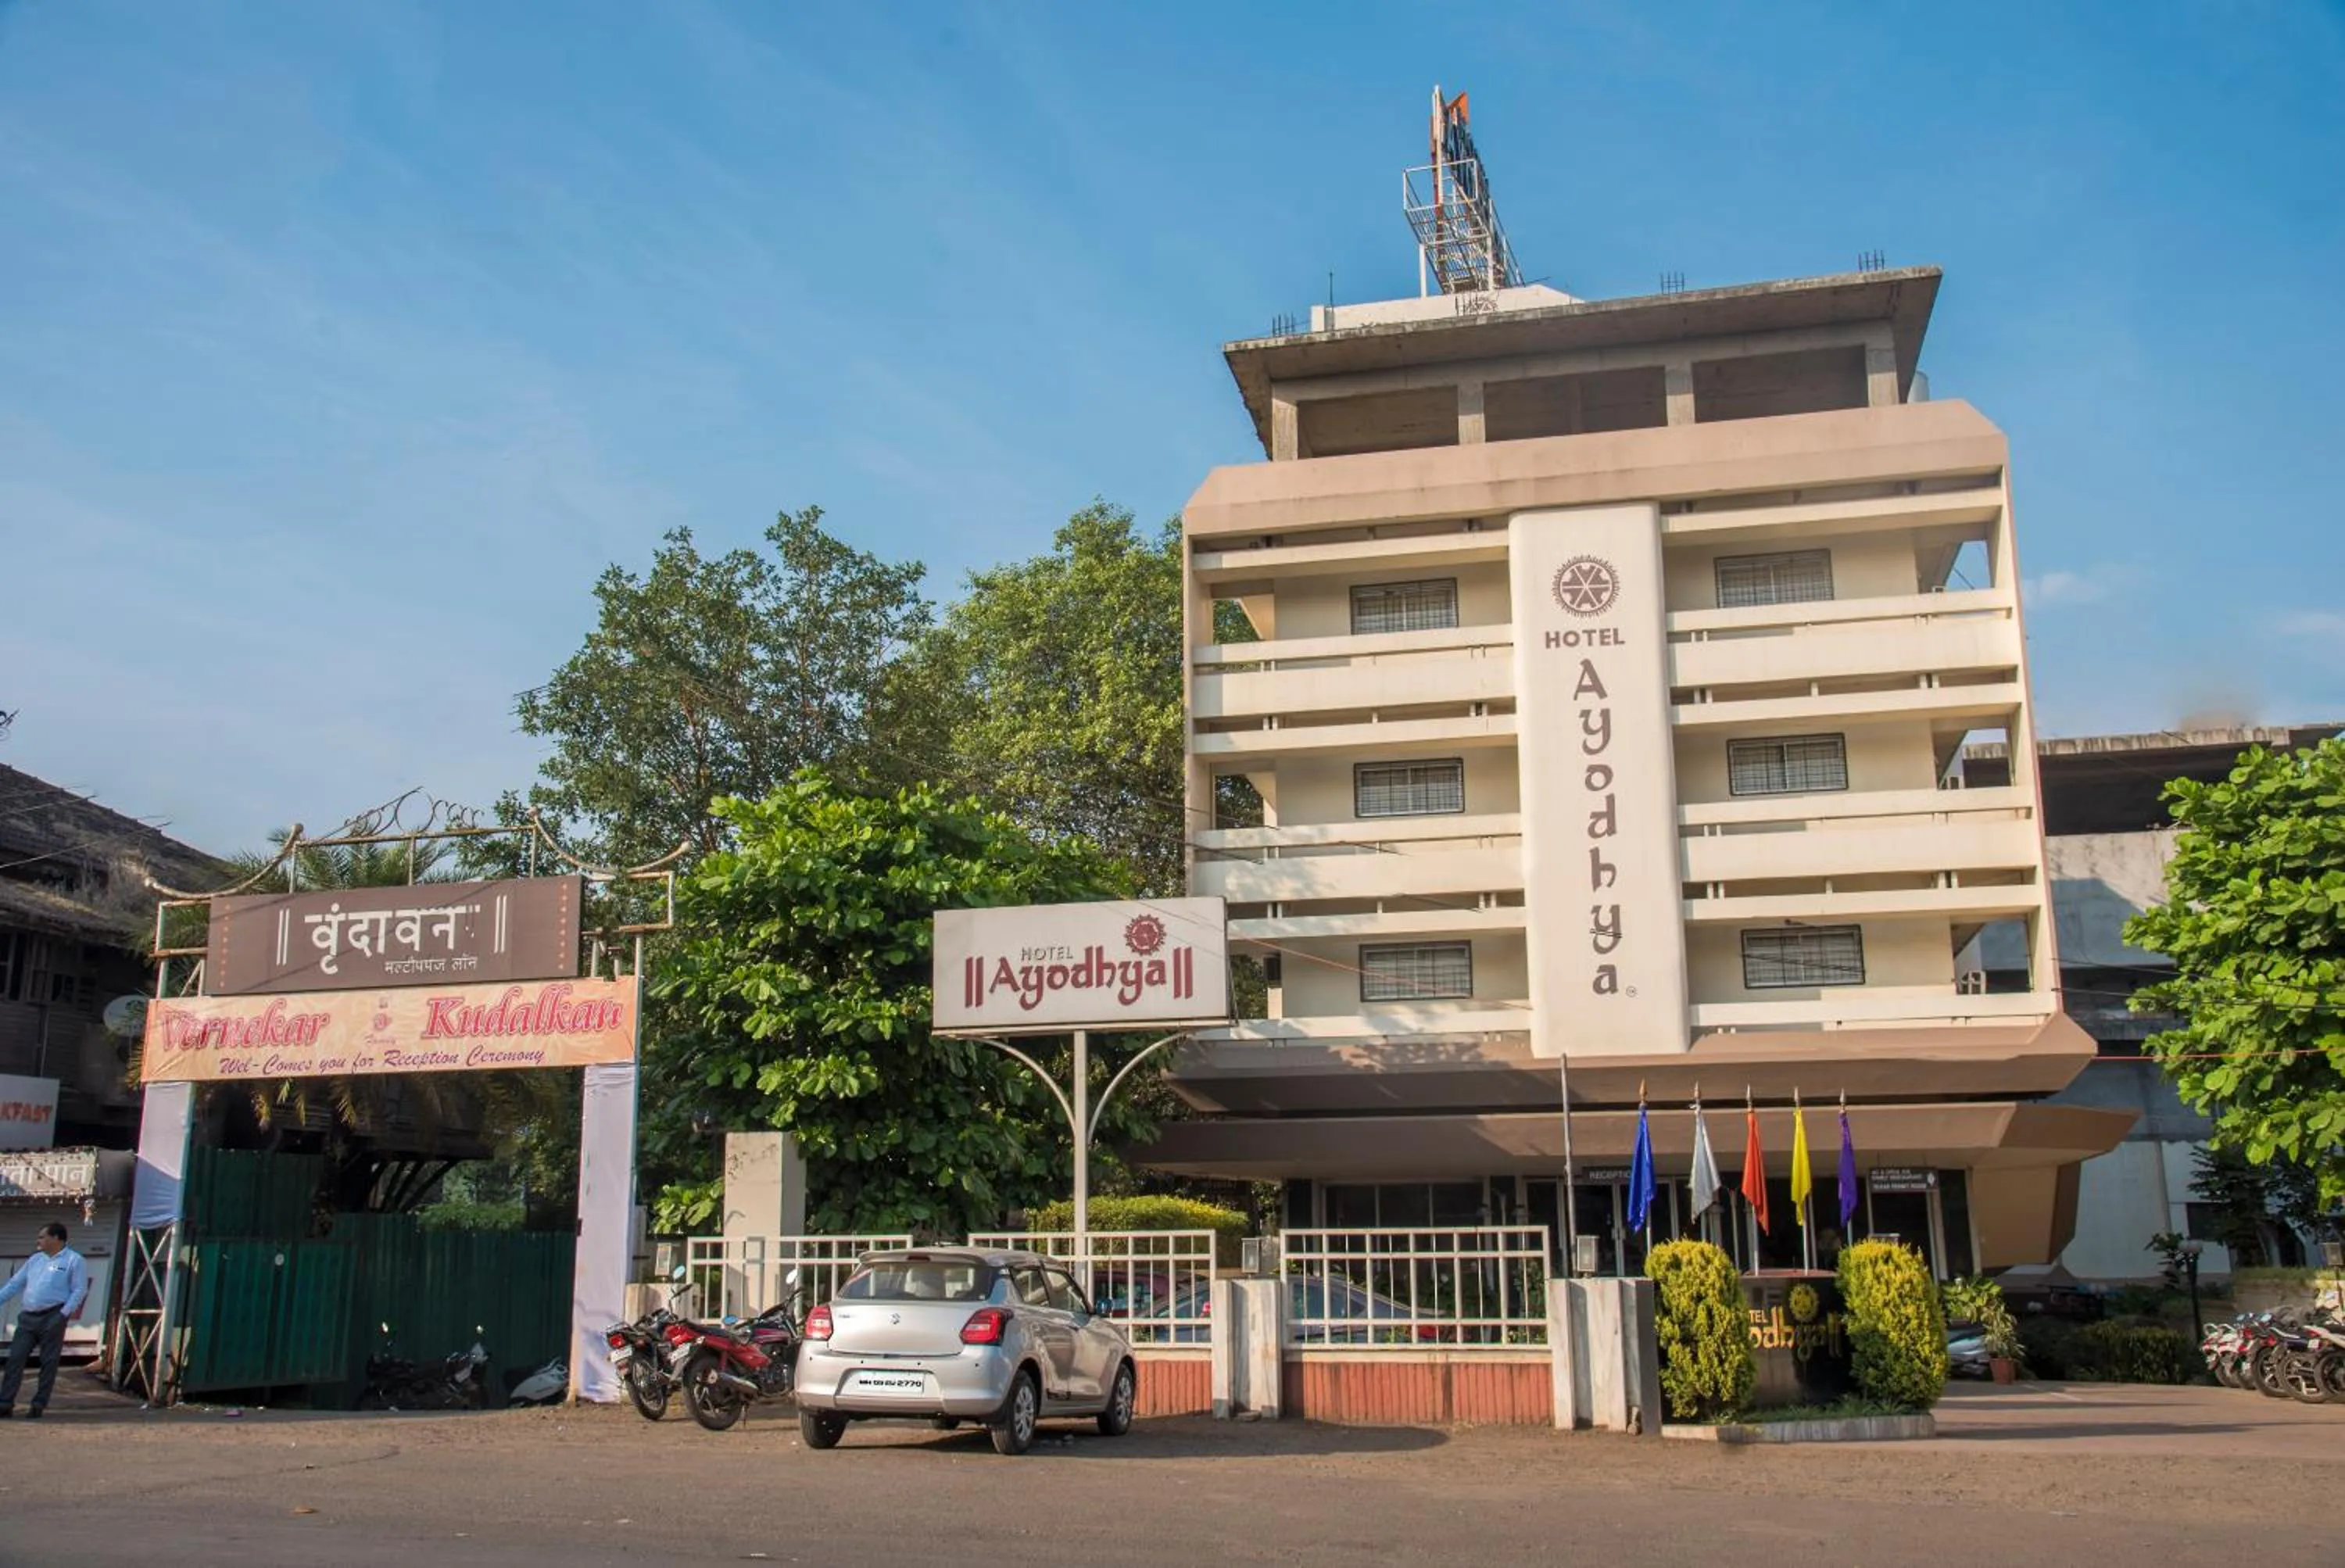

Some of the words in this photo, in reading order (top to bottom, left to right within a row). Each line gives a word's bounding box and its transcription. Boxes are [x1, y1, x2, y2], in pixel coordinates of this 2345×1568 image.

[1545, 628, 1626, 650] HOTEL
[1573, 658, 1623, 995] Ayodhya
[1020, 946, 1073, 961] HOTEL
[989, 945, 1167, 1011] Ayodhya
[319, 1058, 346, 1073] you
[353, 1054, 373, 1075] for
[384, 1049, 460, 1069] Reception
[466, 1044, 545, 1067] Ceremony
[1749, 1309, 1768, 1323] TEL
[1748, 1305, 1827, 1362] odhya
